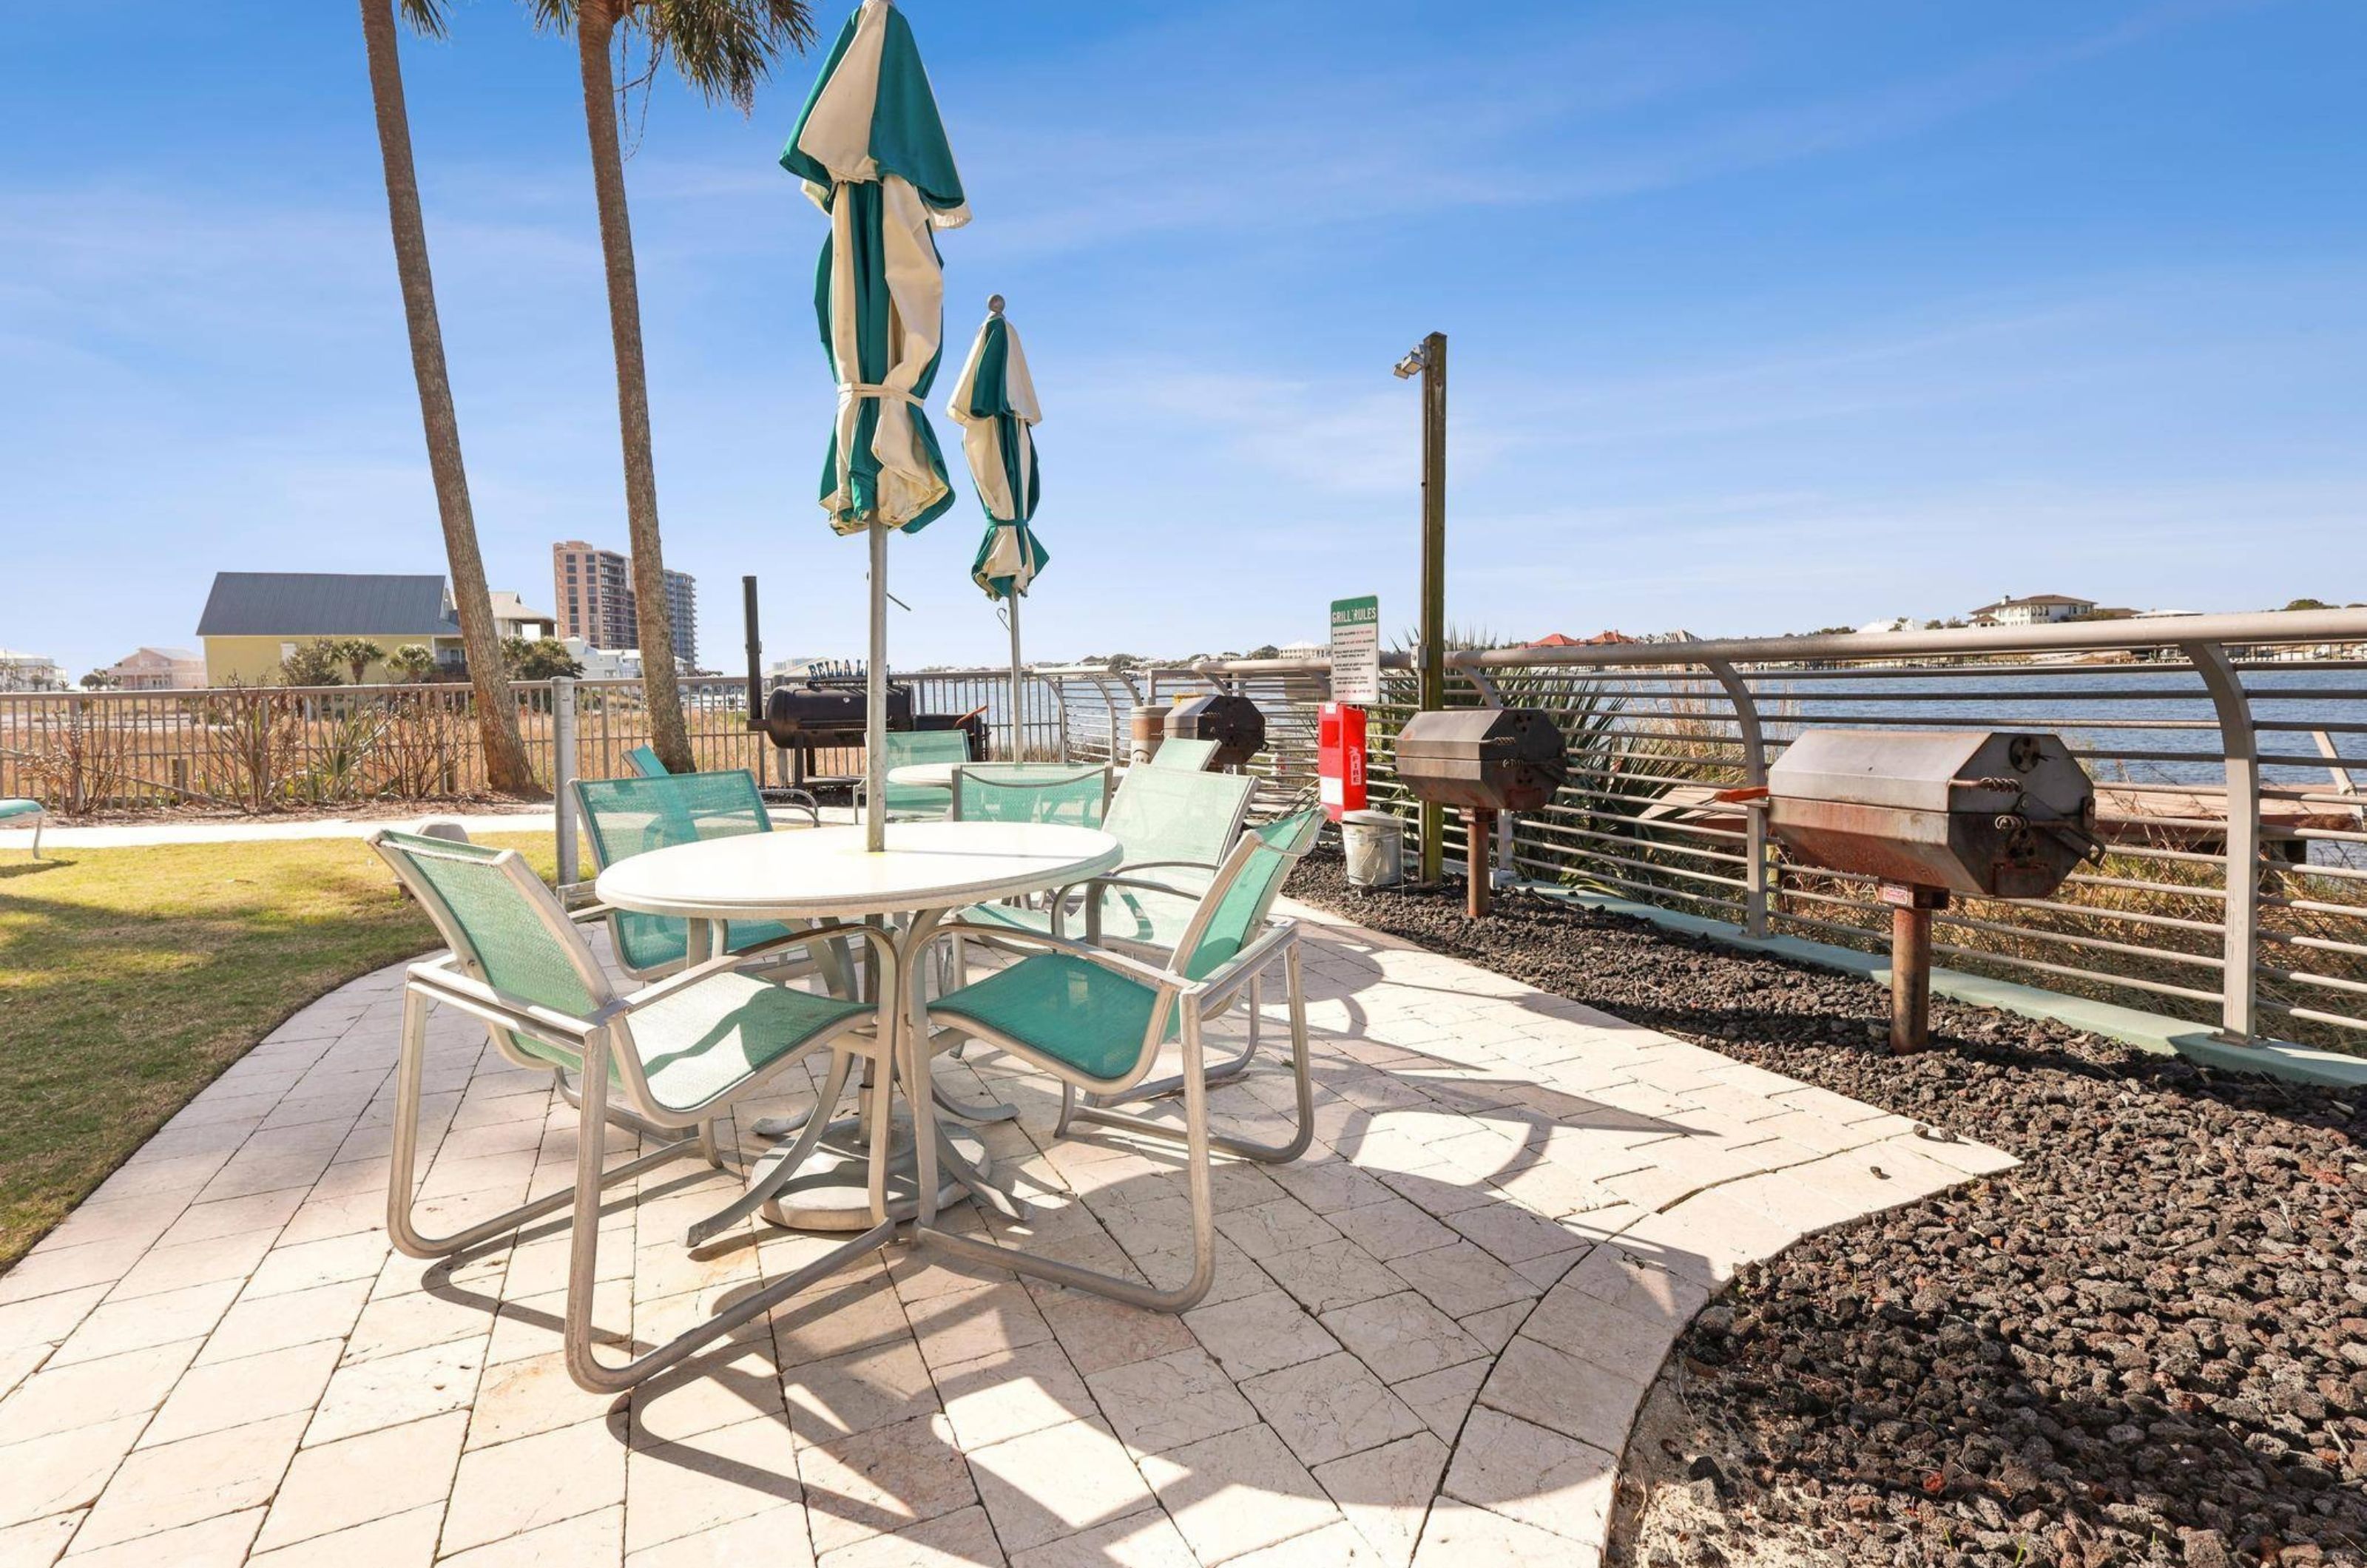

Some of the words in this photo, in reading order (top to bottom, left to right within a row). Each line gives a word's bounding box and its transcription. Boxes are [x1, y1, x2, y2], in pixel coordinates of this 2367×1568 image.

[1332, 610, 1352, 624] GRILL
[1354, 606, 1377, 622] RULES
[808, 659, 852, 681] BELLA
